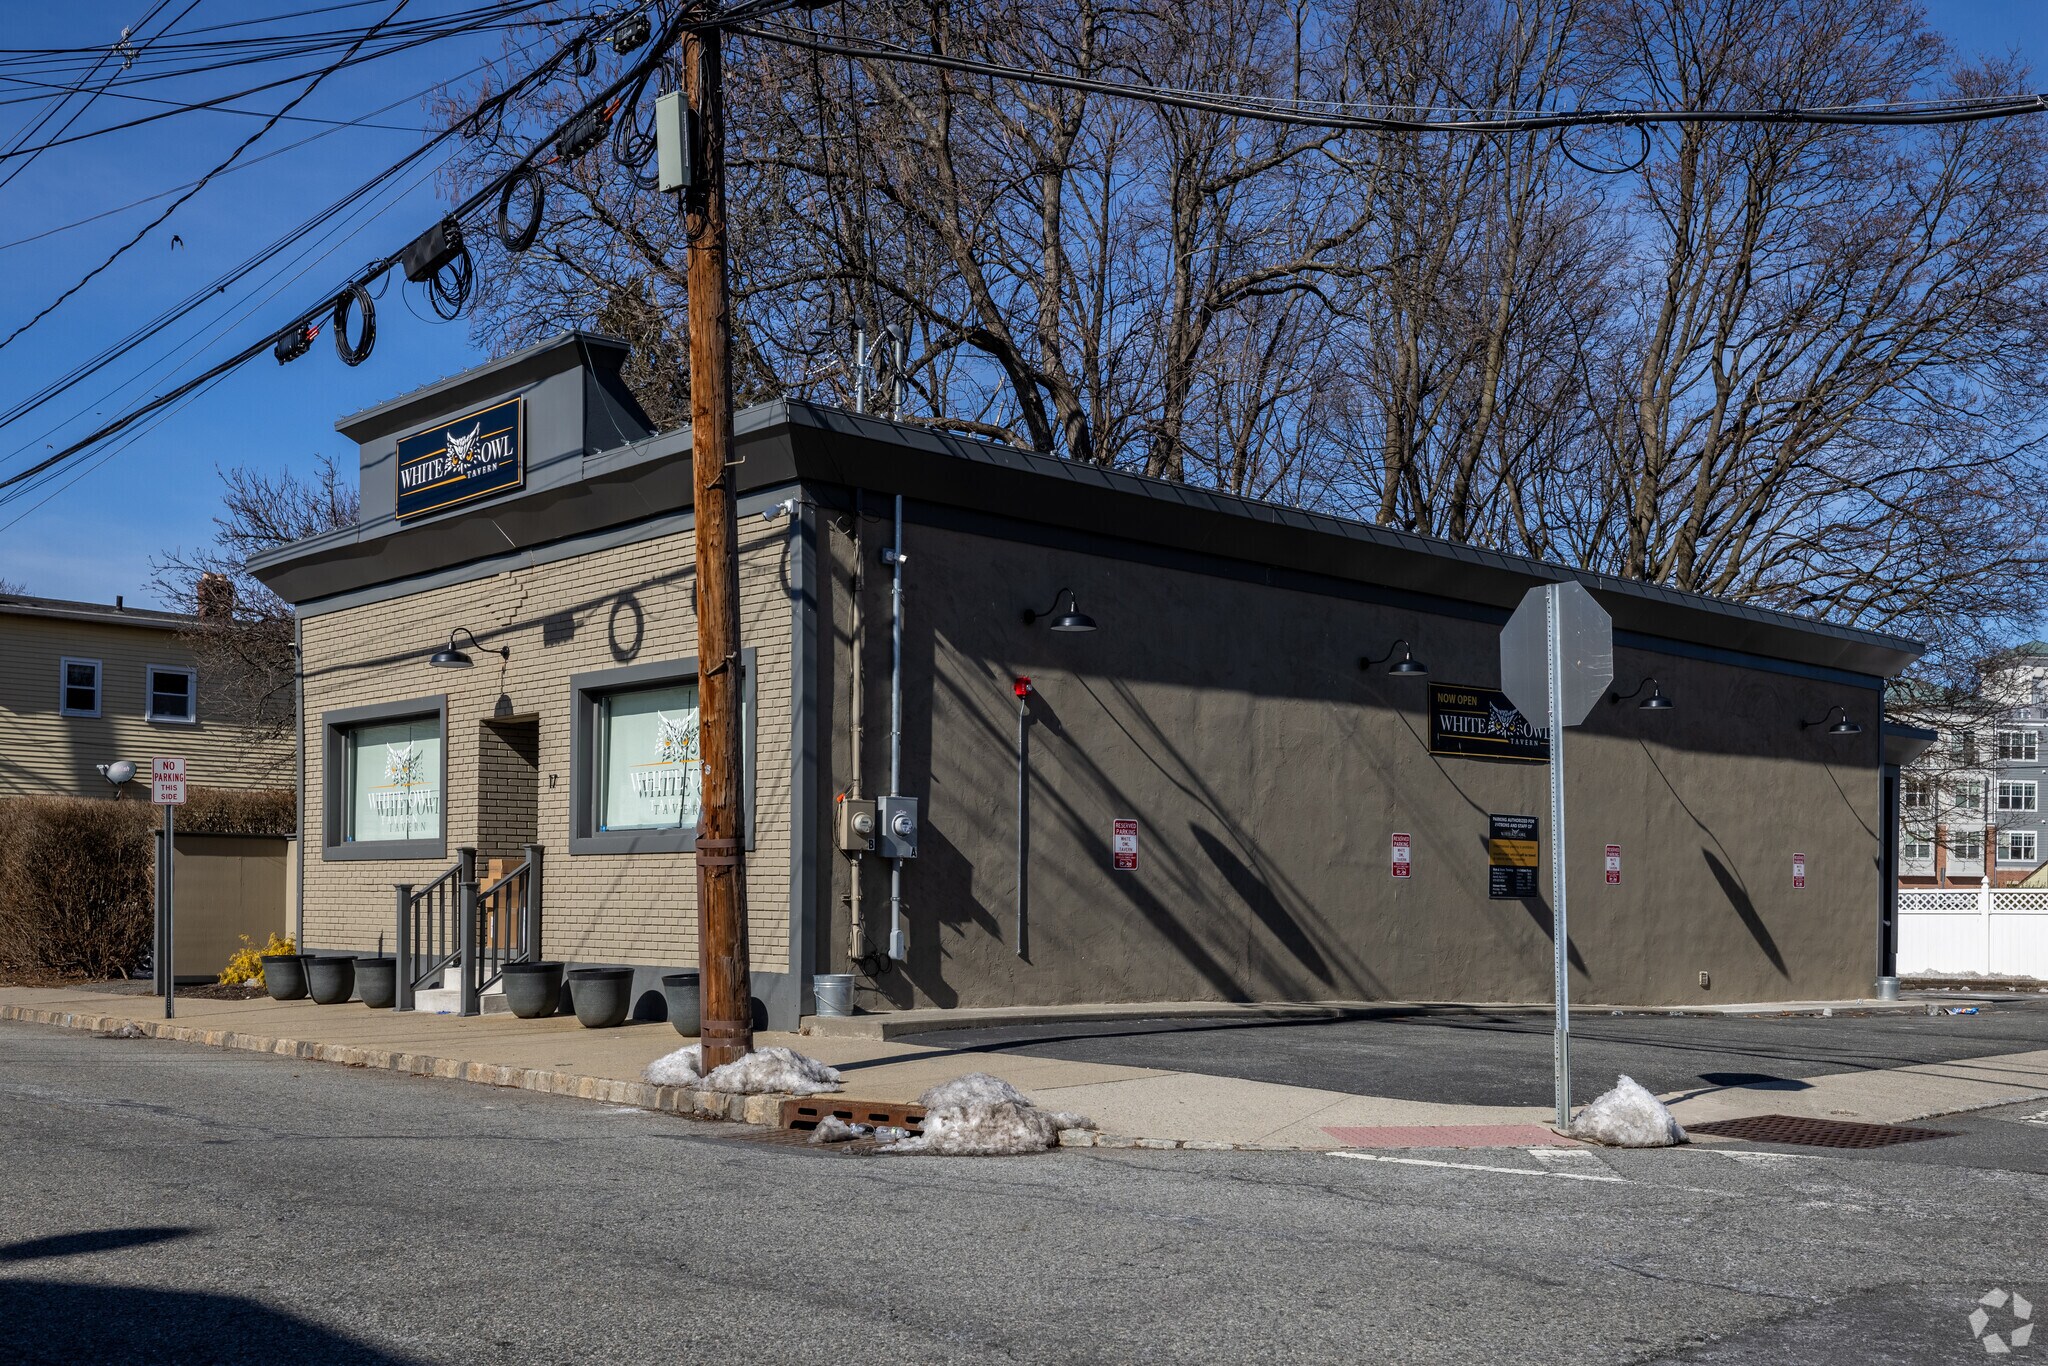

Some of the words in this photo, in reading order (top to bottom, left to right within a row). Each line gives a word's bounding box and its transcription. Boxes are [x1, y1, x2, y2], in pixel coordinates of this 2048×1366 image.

[400, 457, 445, 489] WHITE
[481, 435, 514, 463] OWL
[466, 462, 498, 479] TAVERN
[1437, 693, 1456, 704] NOW
[1457, 695, 1478, 706] OPEN
[1440, 714, 1487, 734] WHITE
[1523, 722, 1551, 740] OWL
[1510, 738, 1539, 747] TAVERN
[162, 761, 175, 770] NO
[154, 772, 184, 782] PARKING
[549, 774, 558, 789] 17
[630, 769, 686, 793] WHITE
[367, 791, 406, 810] WHITE
[408, 789, 435, 808] OWL
[868, 839, 874, 850] B
[910, 847, 917, 858] A
